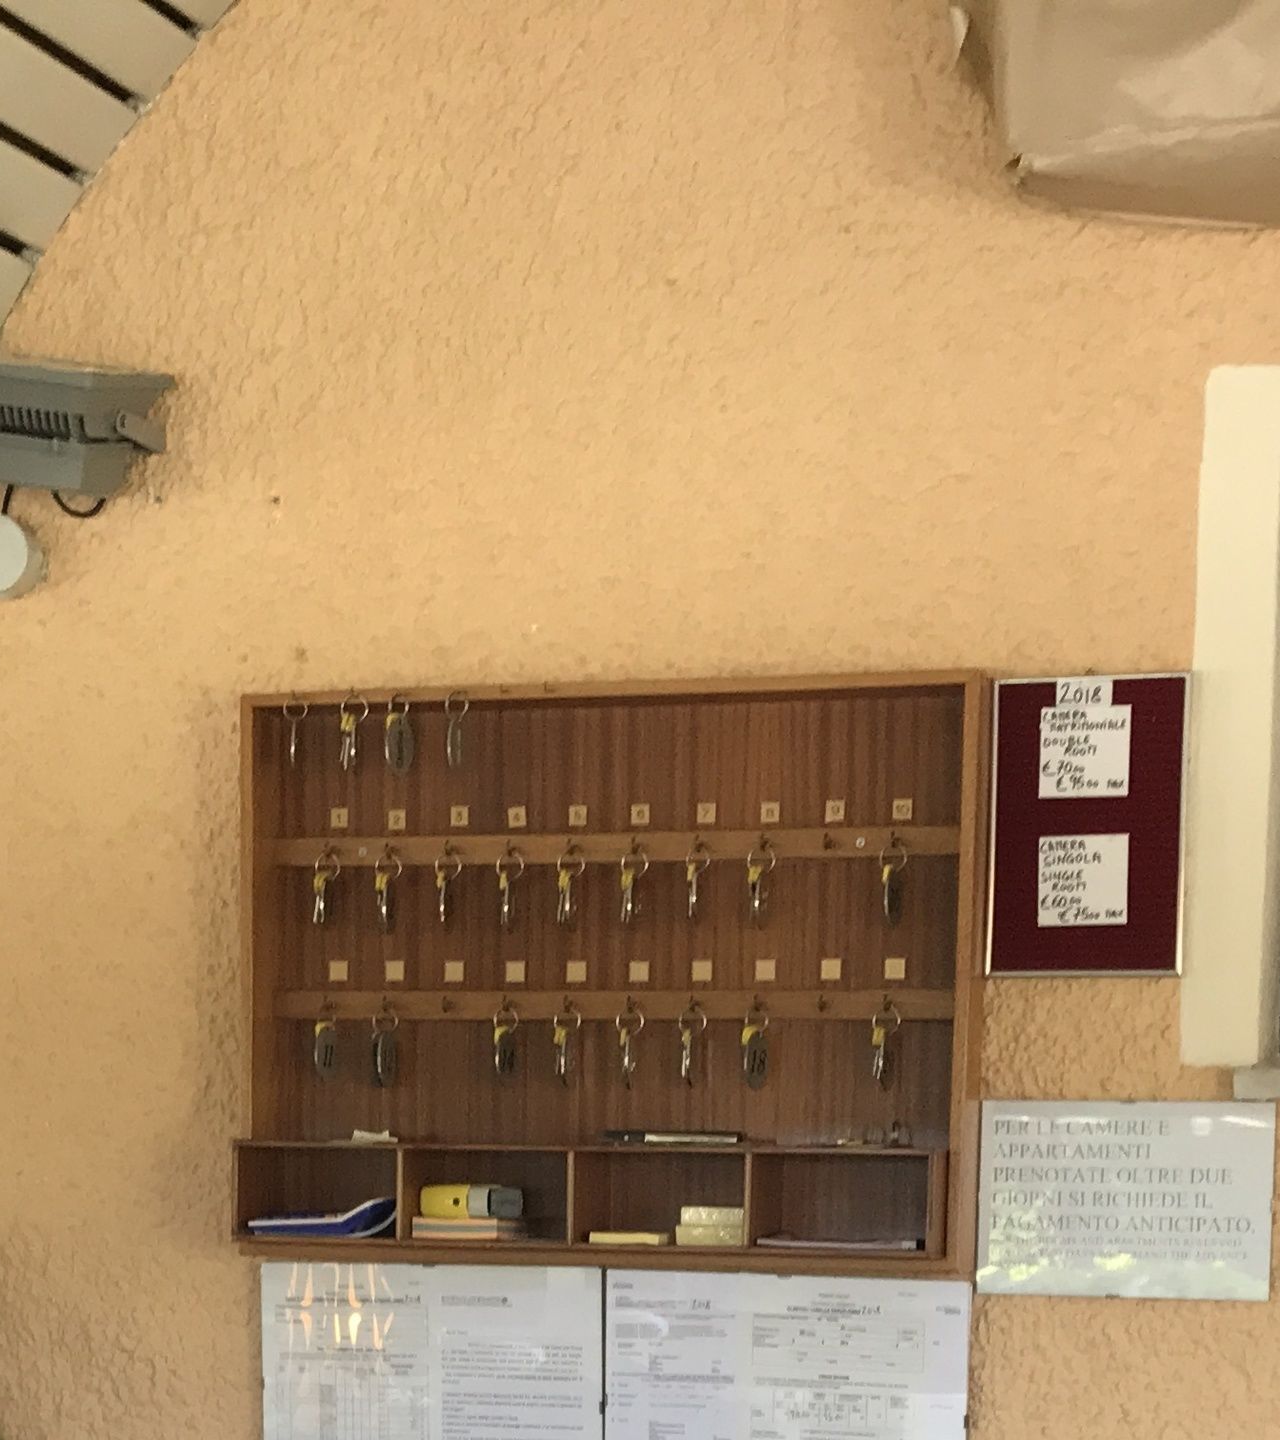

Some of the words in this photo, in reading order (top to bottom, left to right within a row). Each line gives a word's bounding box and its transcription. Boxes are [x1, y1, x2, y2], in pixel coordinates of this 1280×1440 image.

[1059, 682, 1102, 704] 2018
[994, 1119, 1033, 1137] PER
[1037, 1120, 1059, 1137] LE
[1065, 1119, 1154, 1137] CAMERE
[1158, 1120, 1170, 1137] E
[993, 1143, 1152, 1161] APPARTAMENTI
[993, 1167, 1113, 1185] PRENOTATE
[1116, 1167, 1184, 1185] OLTRE
[1190, 1168, 1233, 1186] DUE
[992, 1190, 1062, 1209] GIORNI
[1068, 1190, 1086, 1208] SI
[1088, 1190, 1190, 1209] RICHIEDE
[1194, 1191, 1214, 1209] IL
[991, 1214, 1120, 1233] PAGAMENTO
